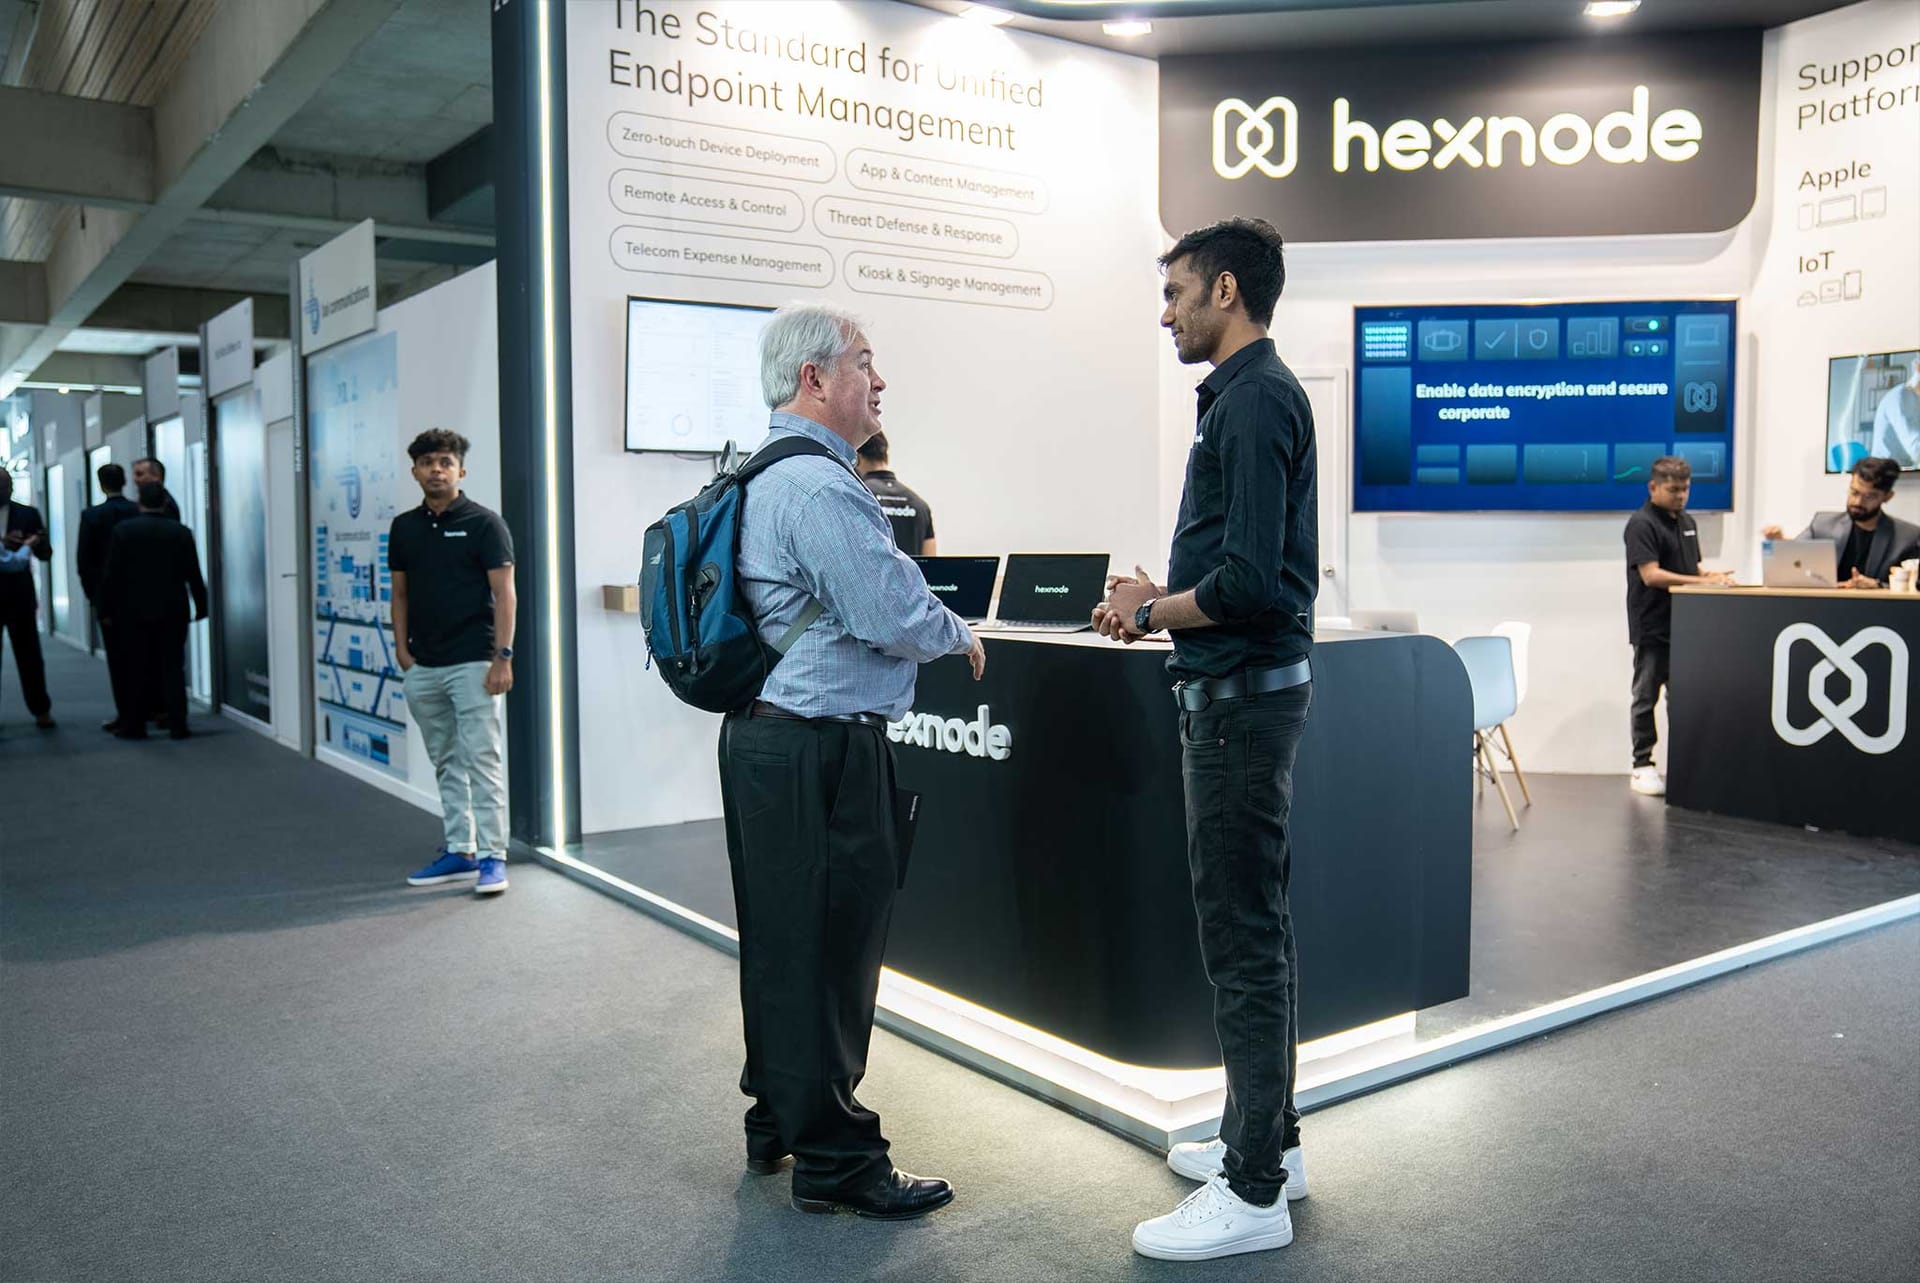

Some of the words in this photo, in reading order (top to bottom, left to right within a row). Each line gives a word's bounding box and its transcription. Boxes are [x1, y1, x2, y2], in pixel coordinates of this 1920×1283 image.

[696, 11, 865, 75] Standard
[878, 46, 924, 84] for
[936, 56, 1043, 108] Unified
[609, 48, 783, 111] Endpoint
[798, 82, 1016, 151] Management
[1332, 85, 1703, 172] hexnode
[622, 127, 696, 150] Zero-touch
[699, 139, 742, 157] Device
[745, 145, 820, 168] Deployment
[860, 163, 887, 181] App
[891, 167, 901, 180] &
[904, 168, 953, 188] Content
[957, 178, 1035, 201] Management
[1799, 160, 1872, 191] Apple
[624, 184, 676, 204] Remote
[680, 193, 725, 209] Access
[729, 198, 738, 211] &
[741, 199, 787, 216] Control
[828, 208, 872, 228] Threat
[876, 215, 928, 235] Defense
[931, 223, 941, 236] &
[945, 224, 1003, 245] Response
[625, 241, 680, 259] Telecom
[683, 248, 737, 266] Expense
[741, 255, 822, 274] Management
[1799, 251, 1834, 274] IoT
[858, 265, 892, 282] Kiosk
[898, 269, 906, 282] &
[910, 270, 961, 288] Signage
[964, 277, 1042, 298] Management
[1416, 383, 1467, 399] Enable
[1468, 383, 1504, 398] data
[1505, 381, 1585, 400] encryption
[1586, 381, 1617, 396] and
[1618, 382, 1669, 396] secure
[1438, 406, 1511, 423] corporate
[1034, 584, 1070, 594] hexnode
[886, 704, 1012, 761] exnode
